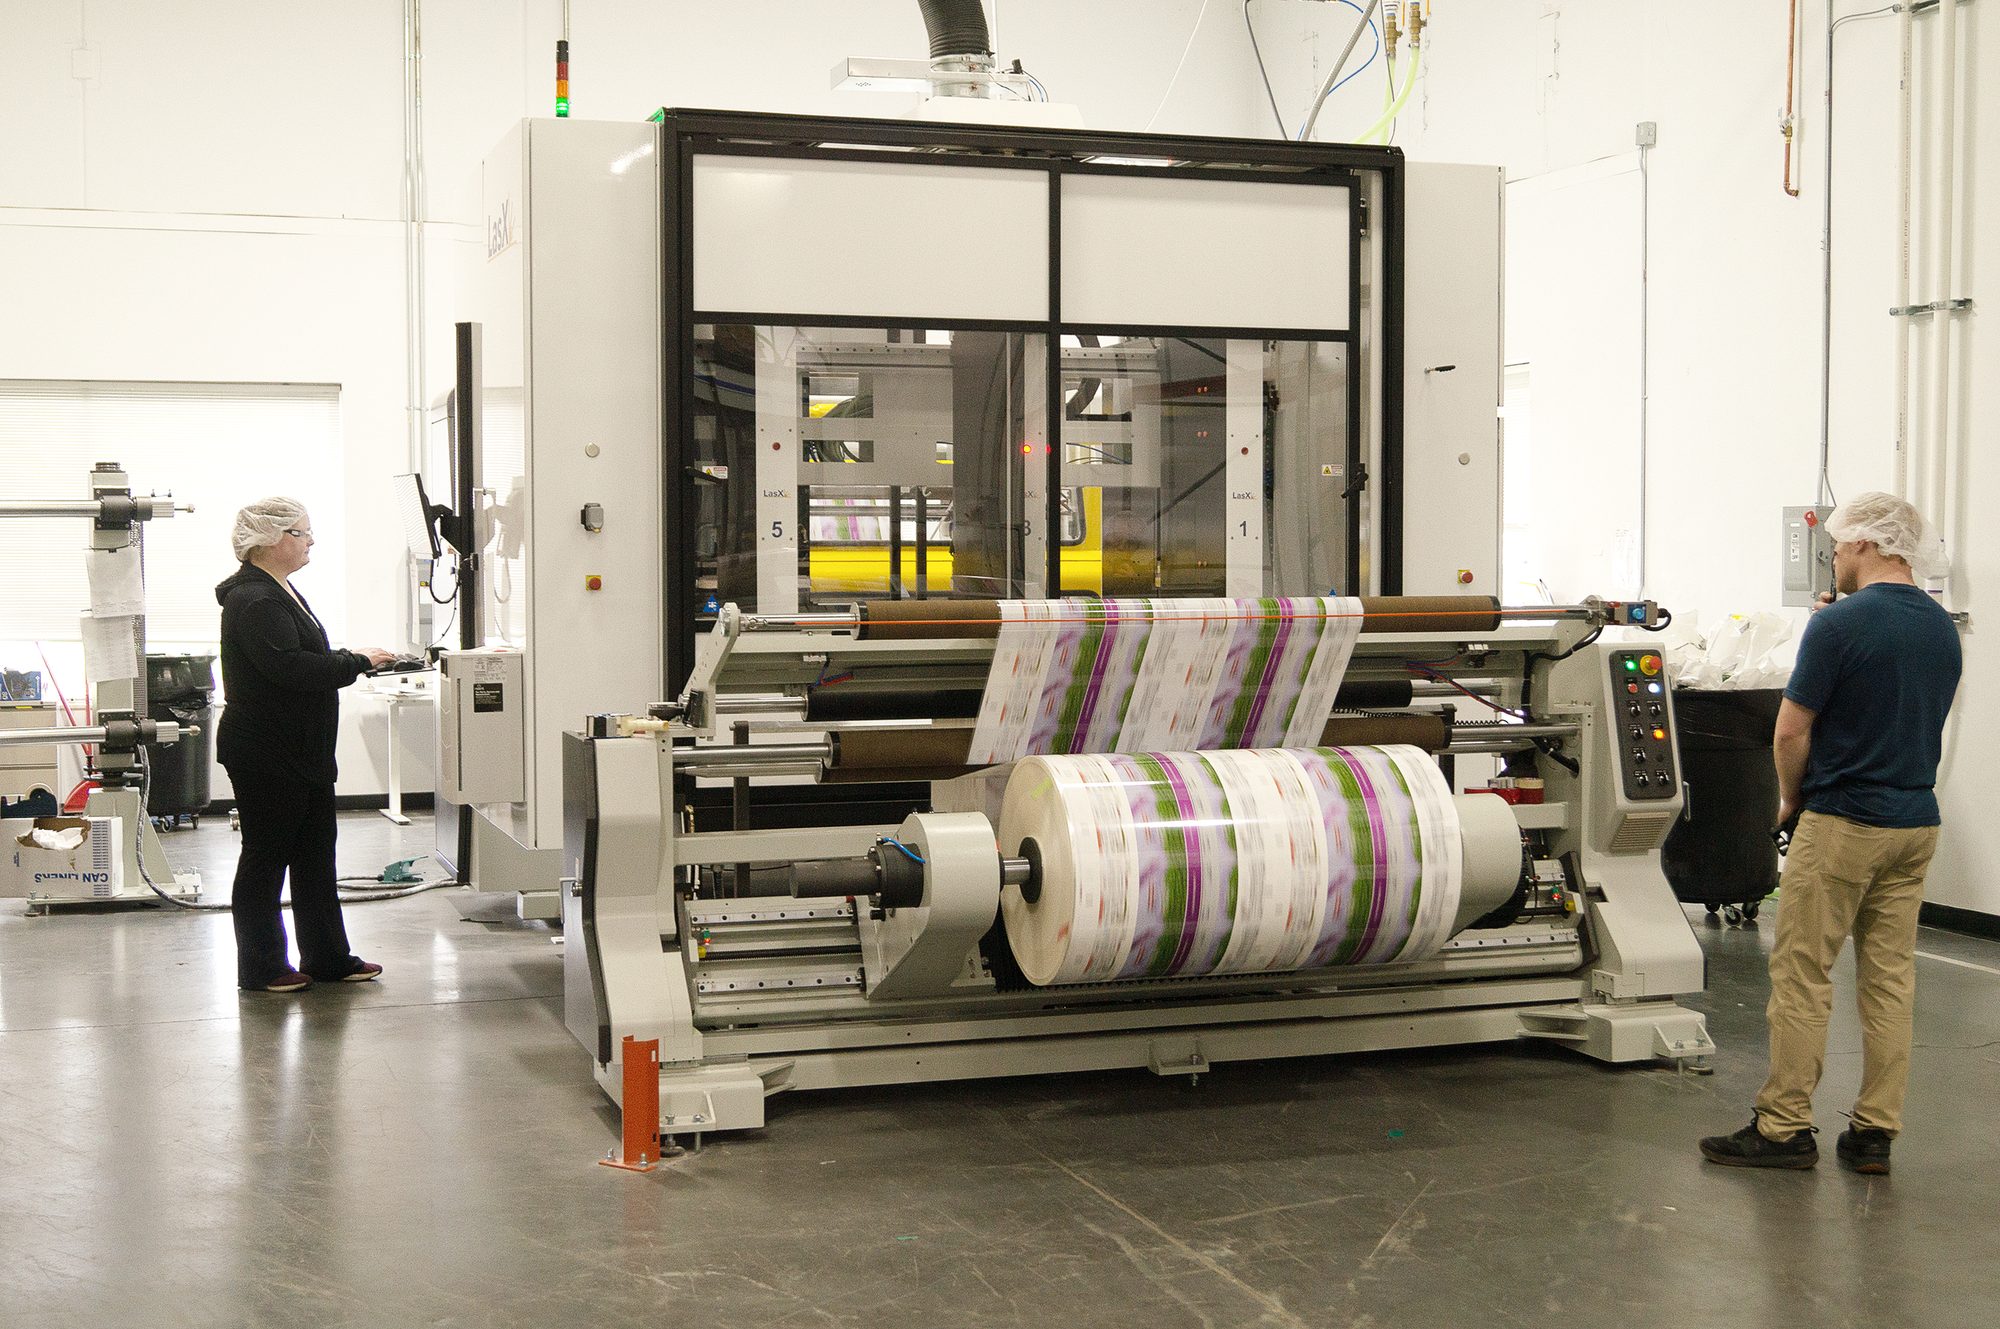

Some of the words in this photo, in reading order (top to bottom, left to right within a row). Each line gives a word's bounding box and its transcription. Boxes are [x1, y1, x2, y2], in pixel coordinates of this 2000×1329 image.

[488, 199, 509, 258] LasX
[763, 489, 785, 498] LasX
[1232, 491, 1251, 500] LasX
[771, 520, 783, 538] 5
[1239, 520, 1247, 537] 1
[83, 872, 109, 883] CAN
